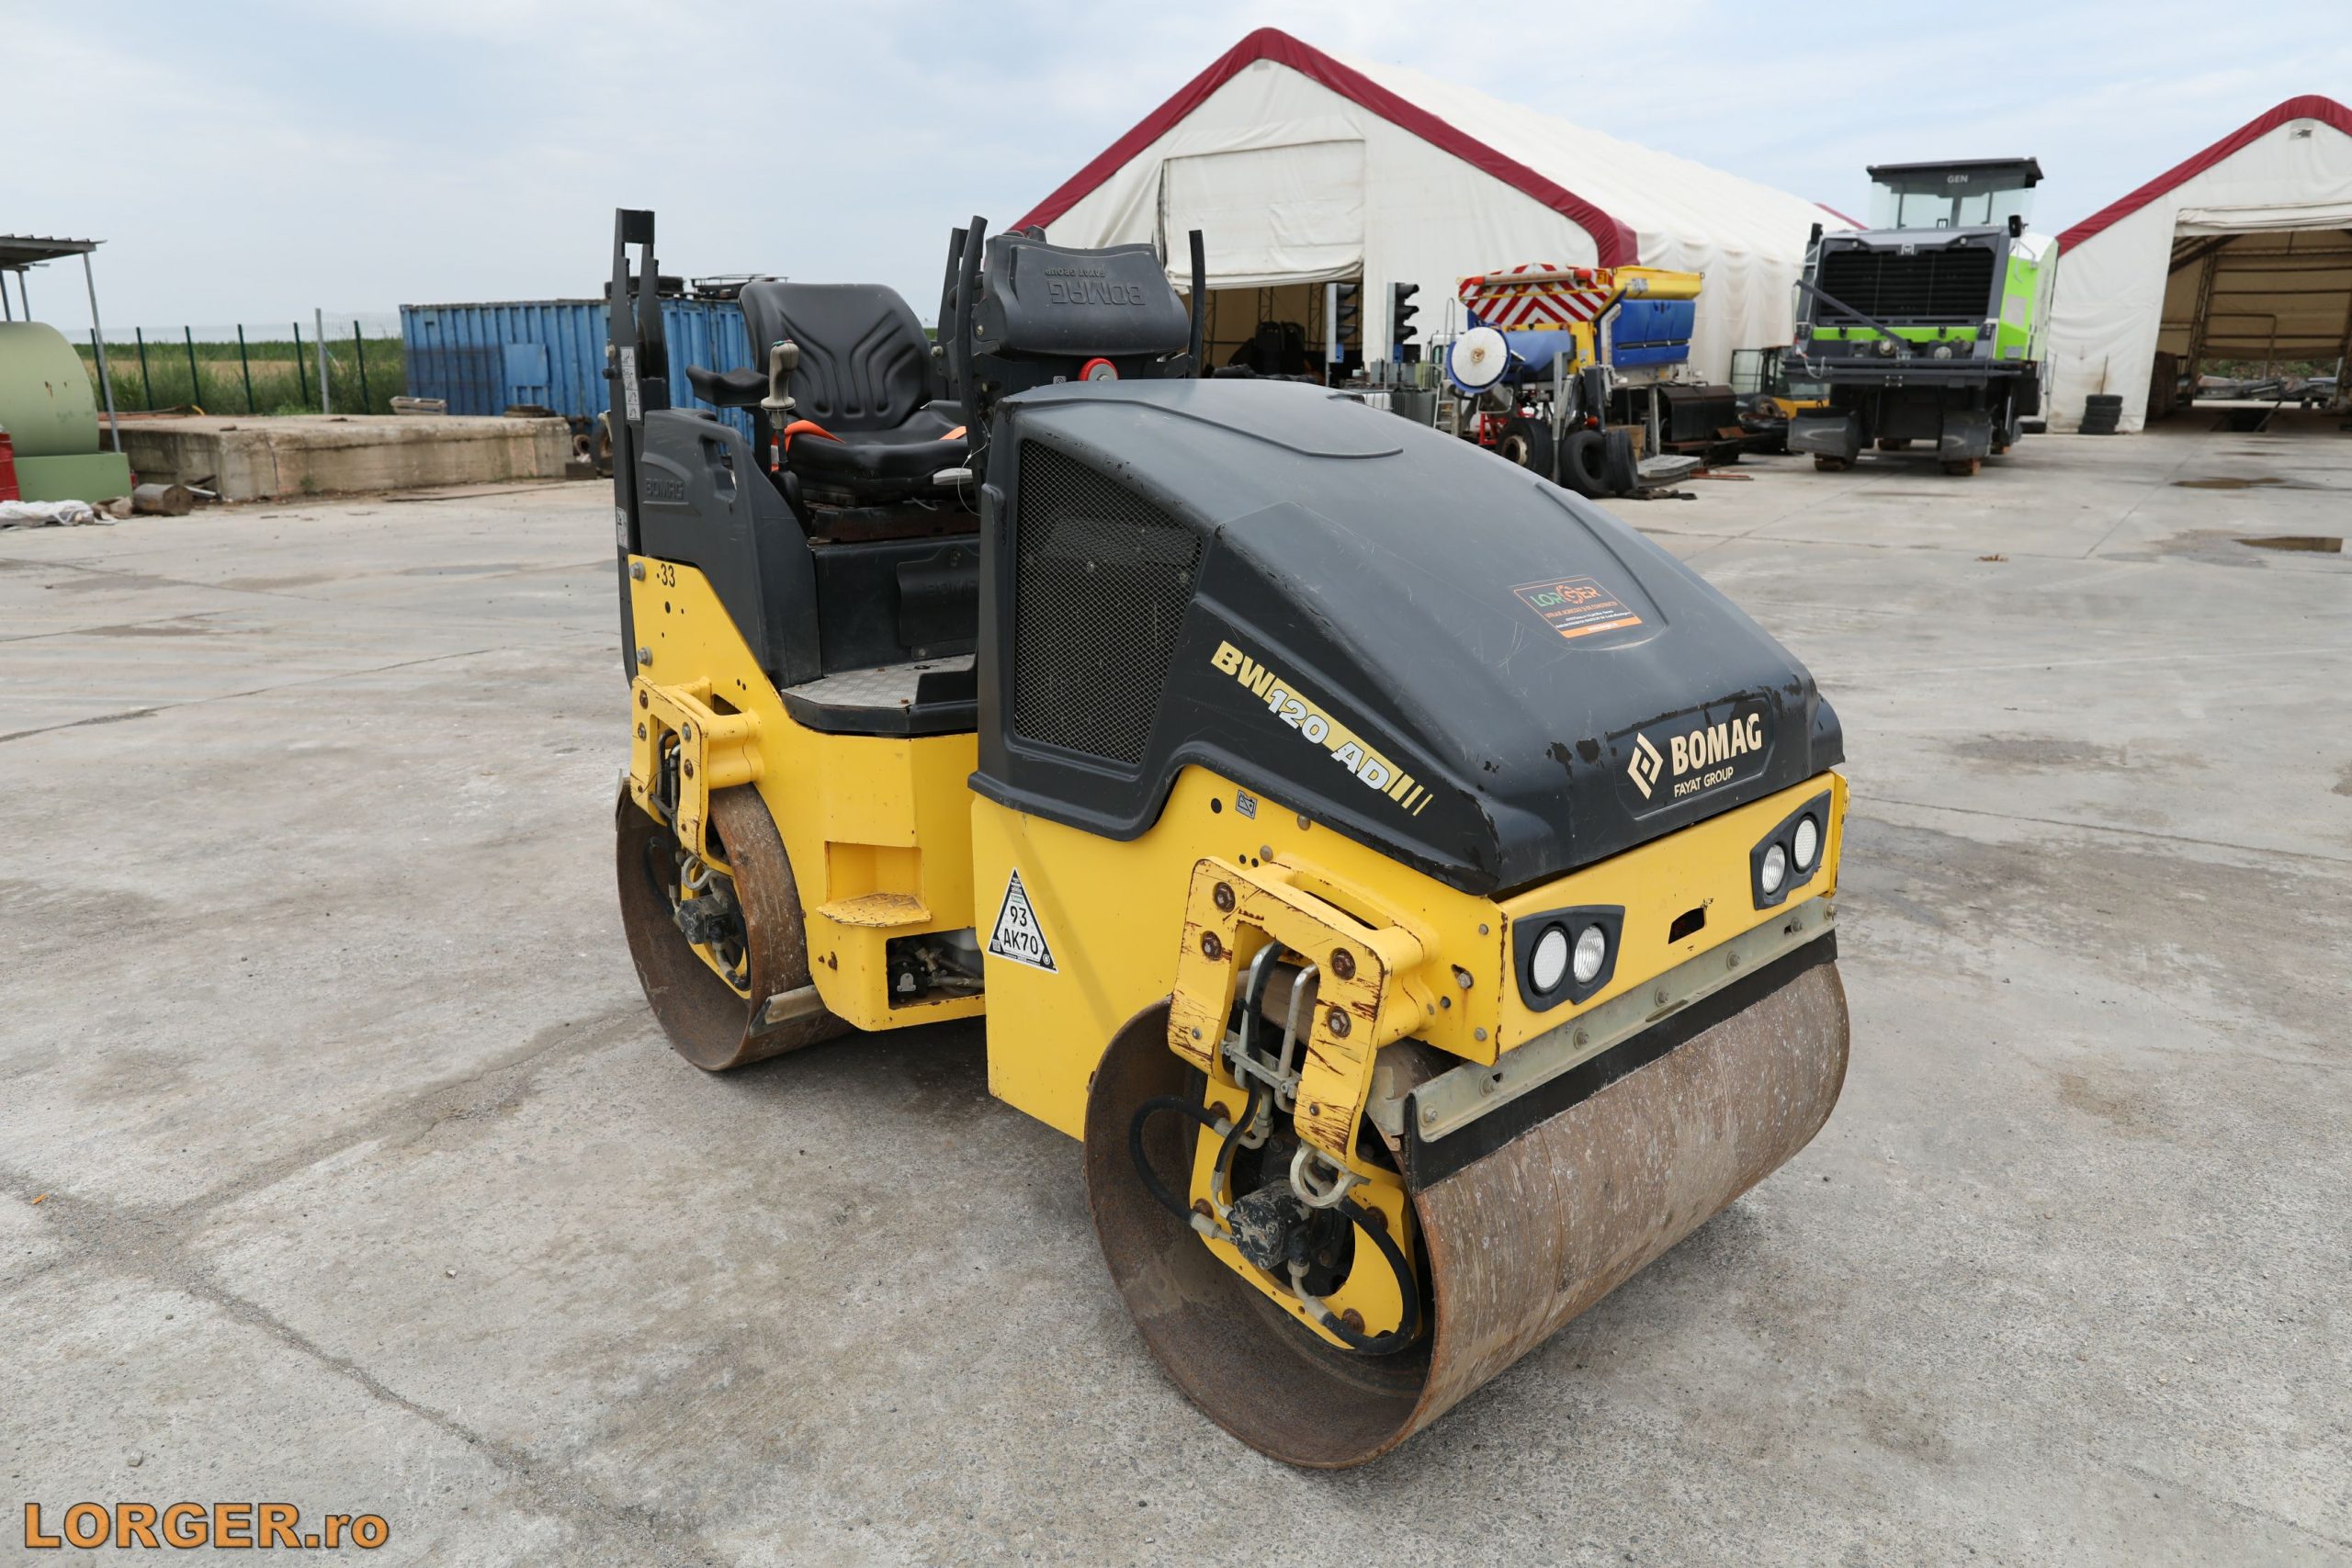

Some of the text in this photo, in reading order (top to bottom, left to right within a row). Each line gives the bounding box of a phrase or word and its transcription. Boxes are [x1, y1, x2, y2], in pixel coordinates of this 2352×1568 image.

[1947, 175, 1968, 184] GEN
[1046, 267, 1074, 276] GROUP
[1048, 280, 1146, 305] BOMAG
[645, 478, 684, 501] BOMAG
[1530, 585, 1601, 606] LORGER
[1210, 640, 1391, 790] BW120 AD
[1670, 713, 1762, 776] BOMAG
[1674, 766, 1734, 797] FAYAT GROUP
[1011, 906, 1027, 927] 93
[1003, 928, 1038, 955] AK70
